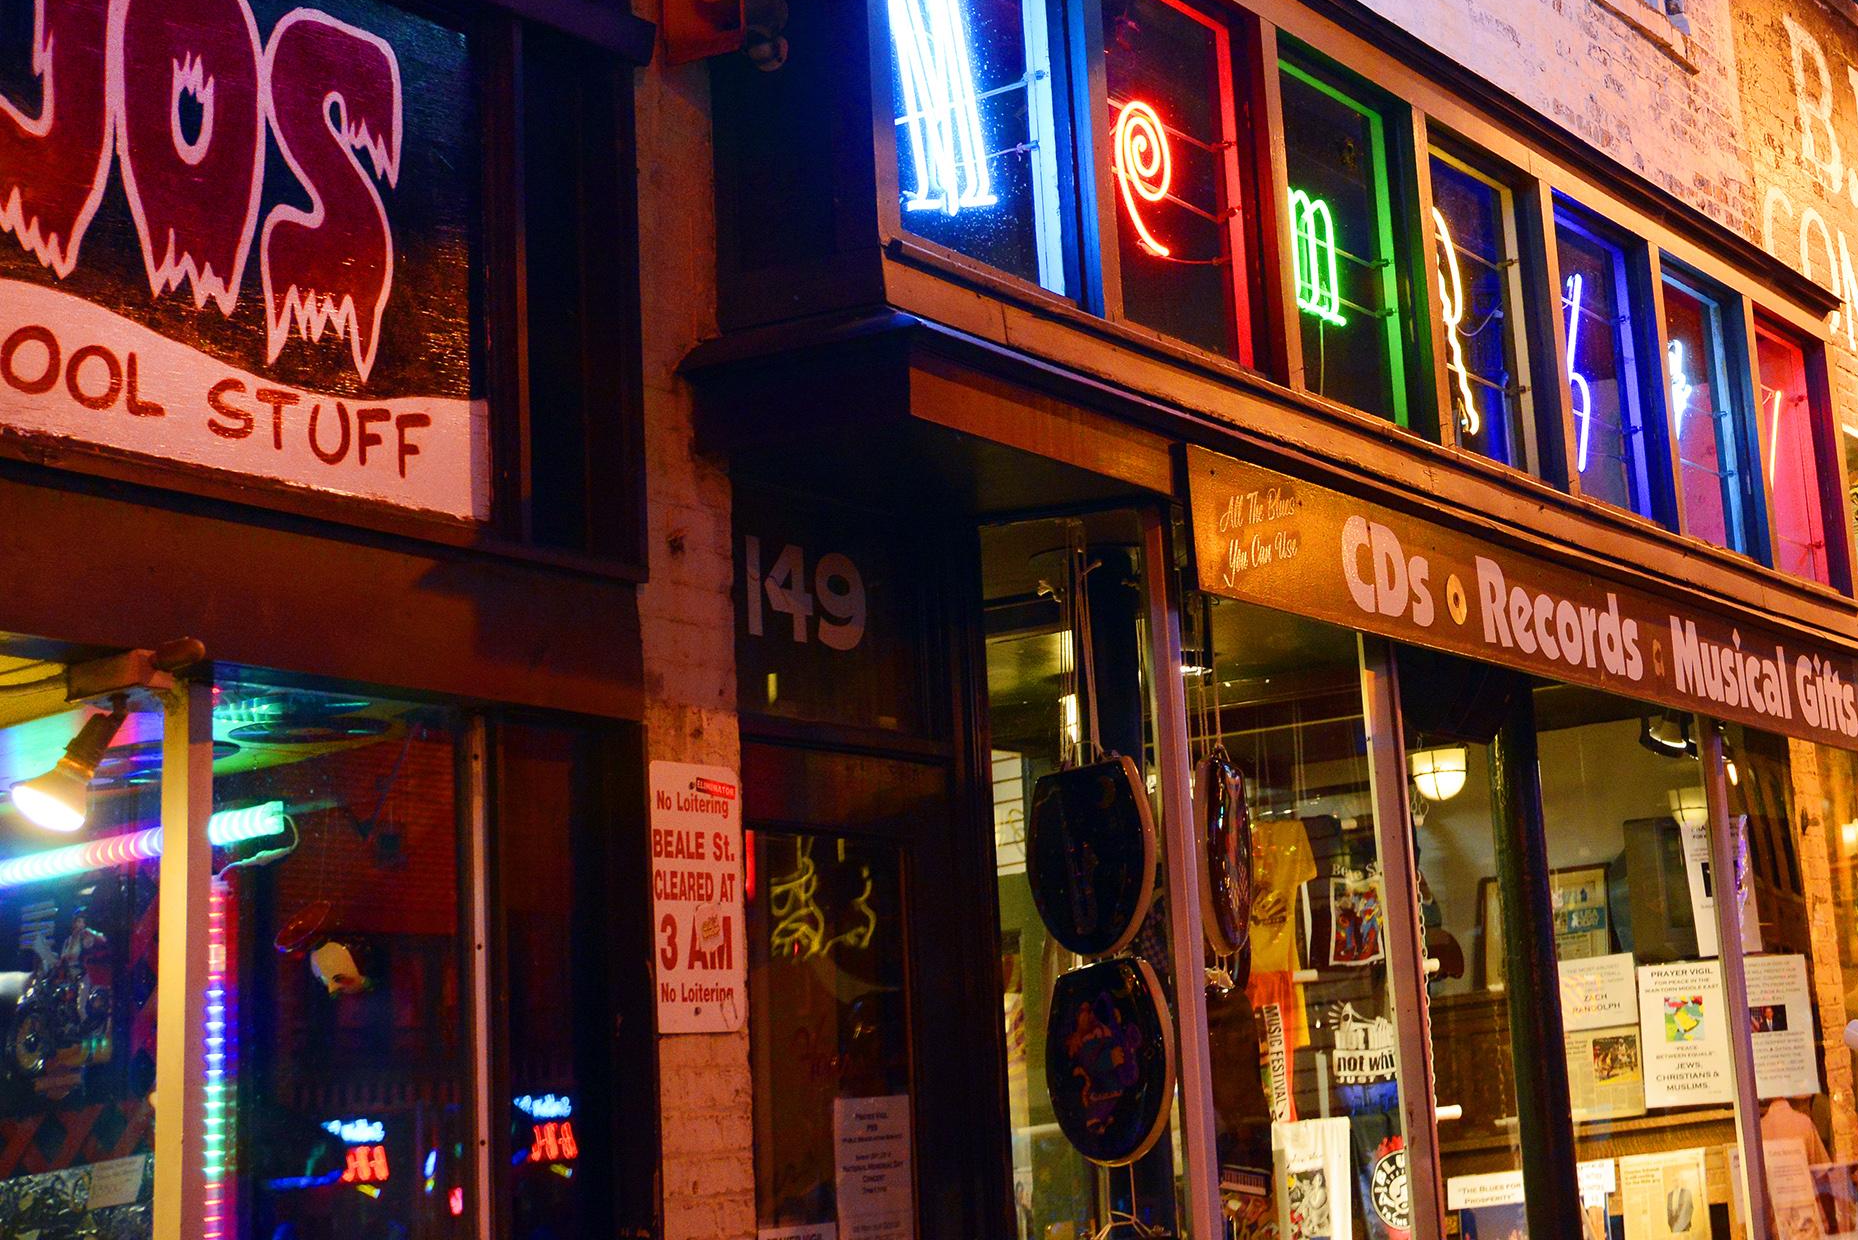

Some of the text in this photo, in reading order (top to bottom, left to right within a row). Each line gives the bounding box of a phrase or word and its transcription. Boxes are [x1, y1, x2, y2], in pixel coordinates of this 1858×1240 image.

[207, 379, 432, 478] STUFF
[1219, 495, 1244, 532] All
[1246, 490, 1265, 525] The
[1223, 531, 1298, 587] You Can Use
[746, 534, 868, 652] 149
[1341, 514, 1435, 627] CDs
[1475, 555, 1644, 681] Records
[1669, 614, 1793, 719] Musical
[656, 790, 729, 819] No Loitering
[653, 828, 735, 862] BEALE St.
[654, 870, 735, 903] CLEARED AT
[660, 913, 678, 971] 3
[688, 915, 733, 970] AM
[1650, 967, 1713, 978] PRAYER VIGIL
[661, 982, 734, 1003] No Loitering
[1263, 1005, 1288, 1105] MUSIC FESTIVAL
[1337, 1055, 1364, 1072] not
[1656, 1071, 1712, 1082] CHRISTIANS
